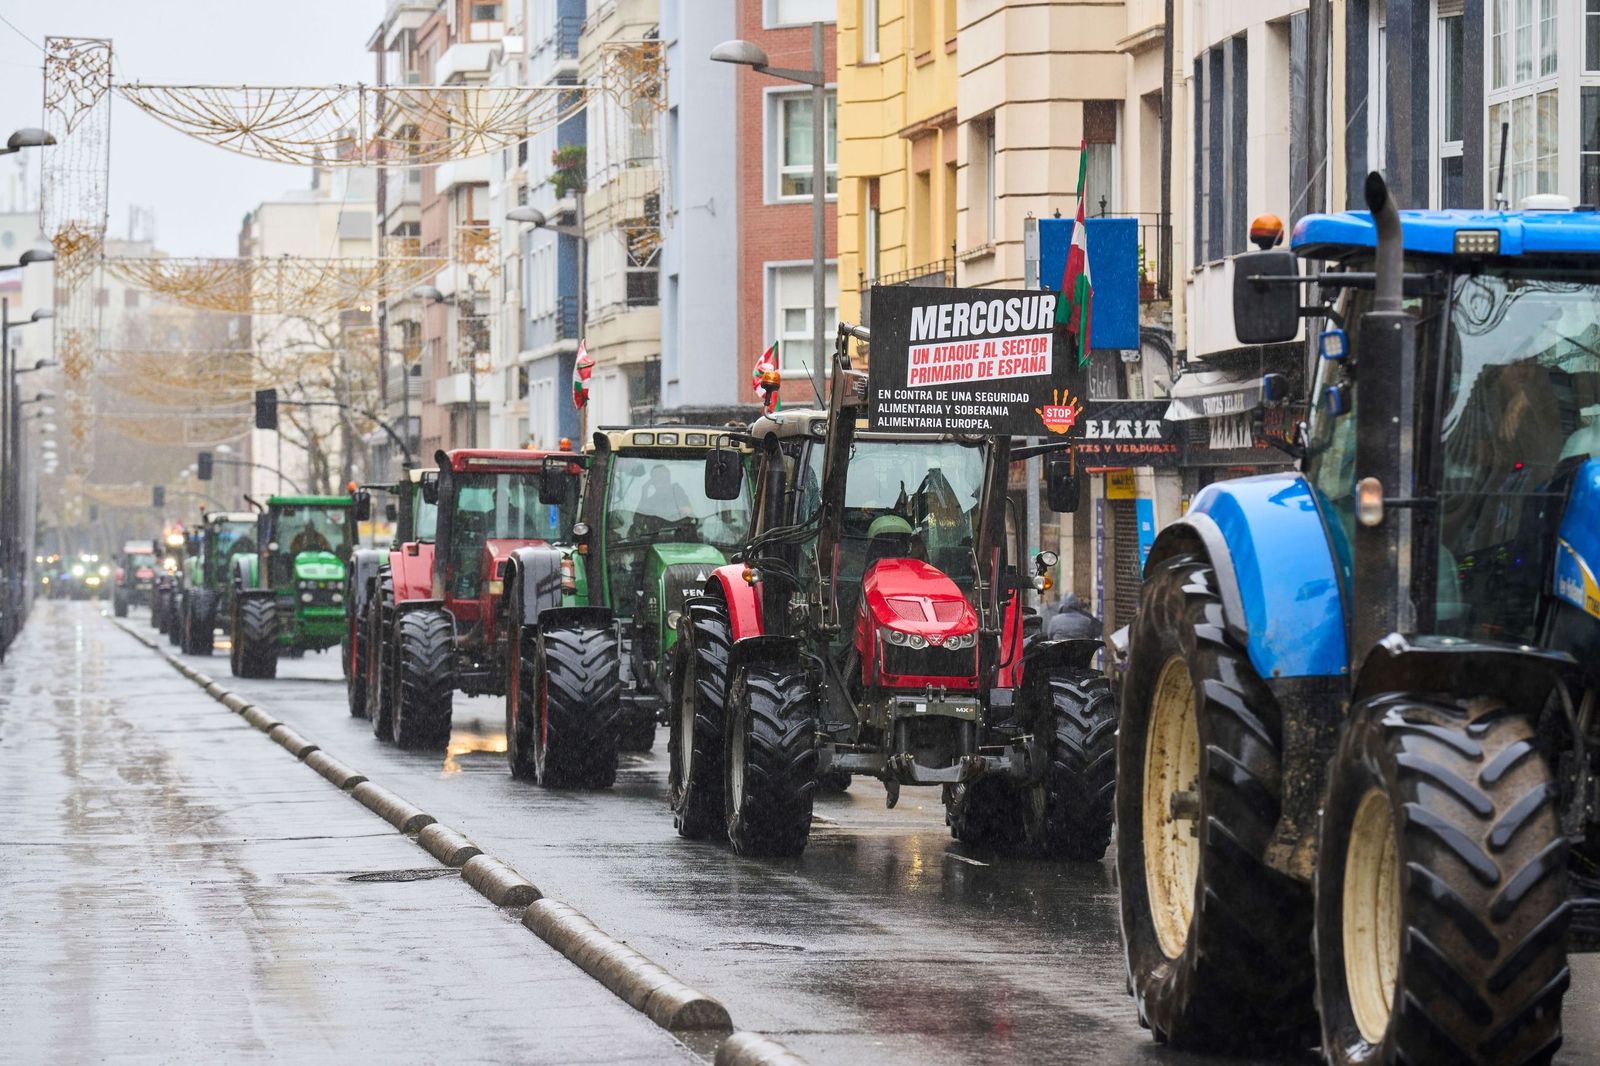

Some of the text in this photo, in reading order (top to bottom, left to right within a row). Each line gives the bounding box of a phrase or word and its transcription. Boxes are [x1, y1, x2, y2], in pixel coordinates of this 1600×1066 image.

[910, 295, 1056, 341] MERCOSUR
[912, 337, 1047, 365] UN ATAQUE AL SECTOR
[910, 353, 1046, 385] PRIMARIO DE ESPAÑA
[878, 389, 1030, 403] EN CONTRA DE UNA SEGURIDAD
[877, 403, 1009, 416] ALIMENTARIA Y SOBERANIA
[1046, 408, 1072, 418] STOP
[877, 416, 993, 429] ALIMENTARIA EUROPEA.
[1085, 420, 1162, 438] ELAiA
[1104, 445, 1111, 453] Y
[682, 589, 705, 597] FEN
